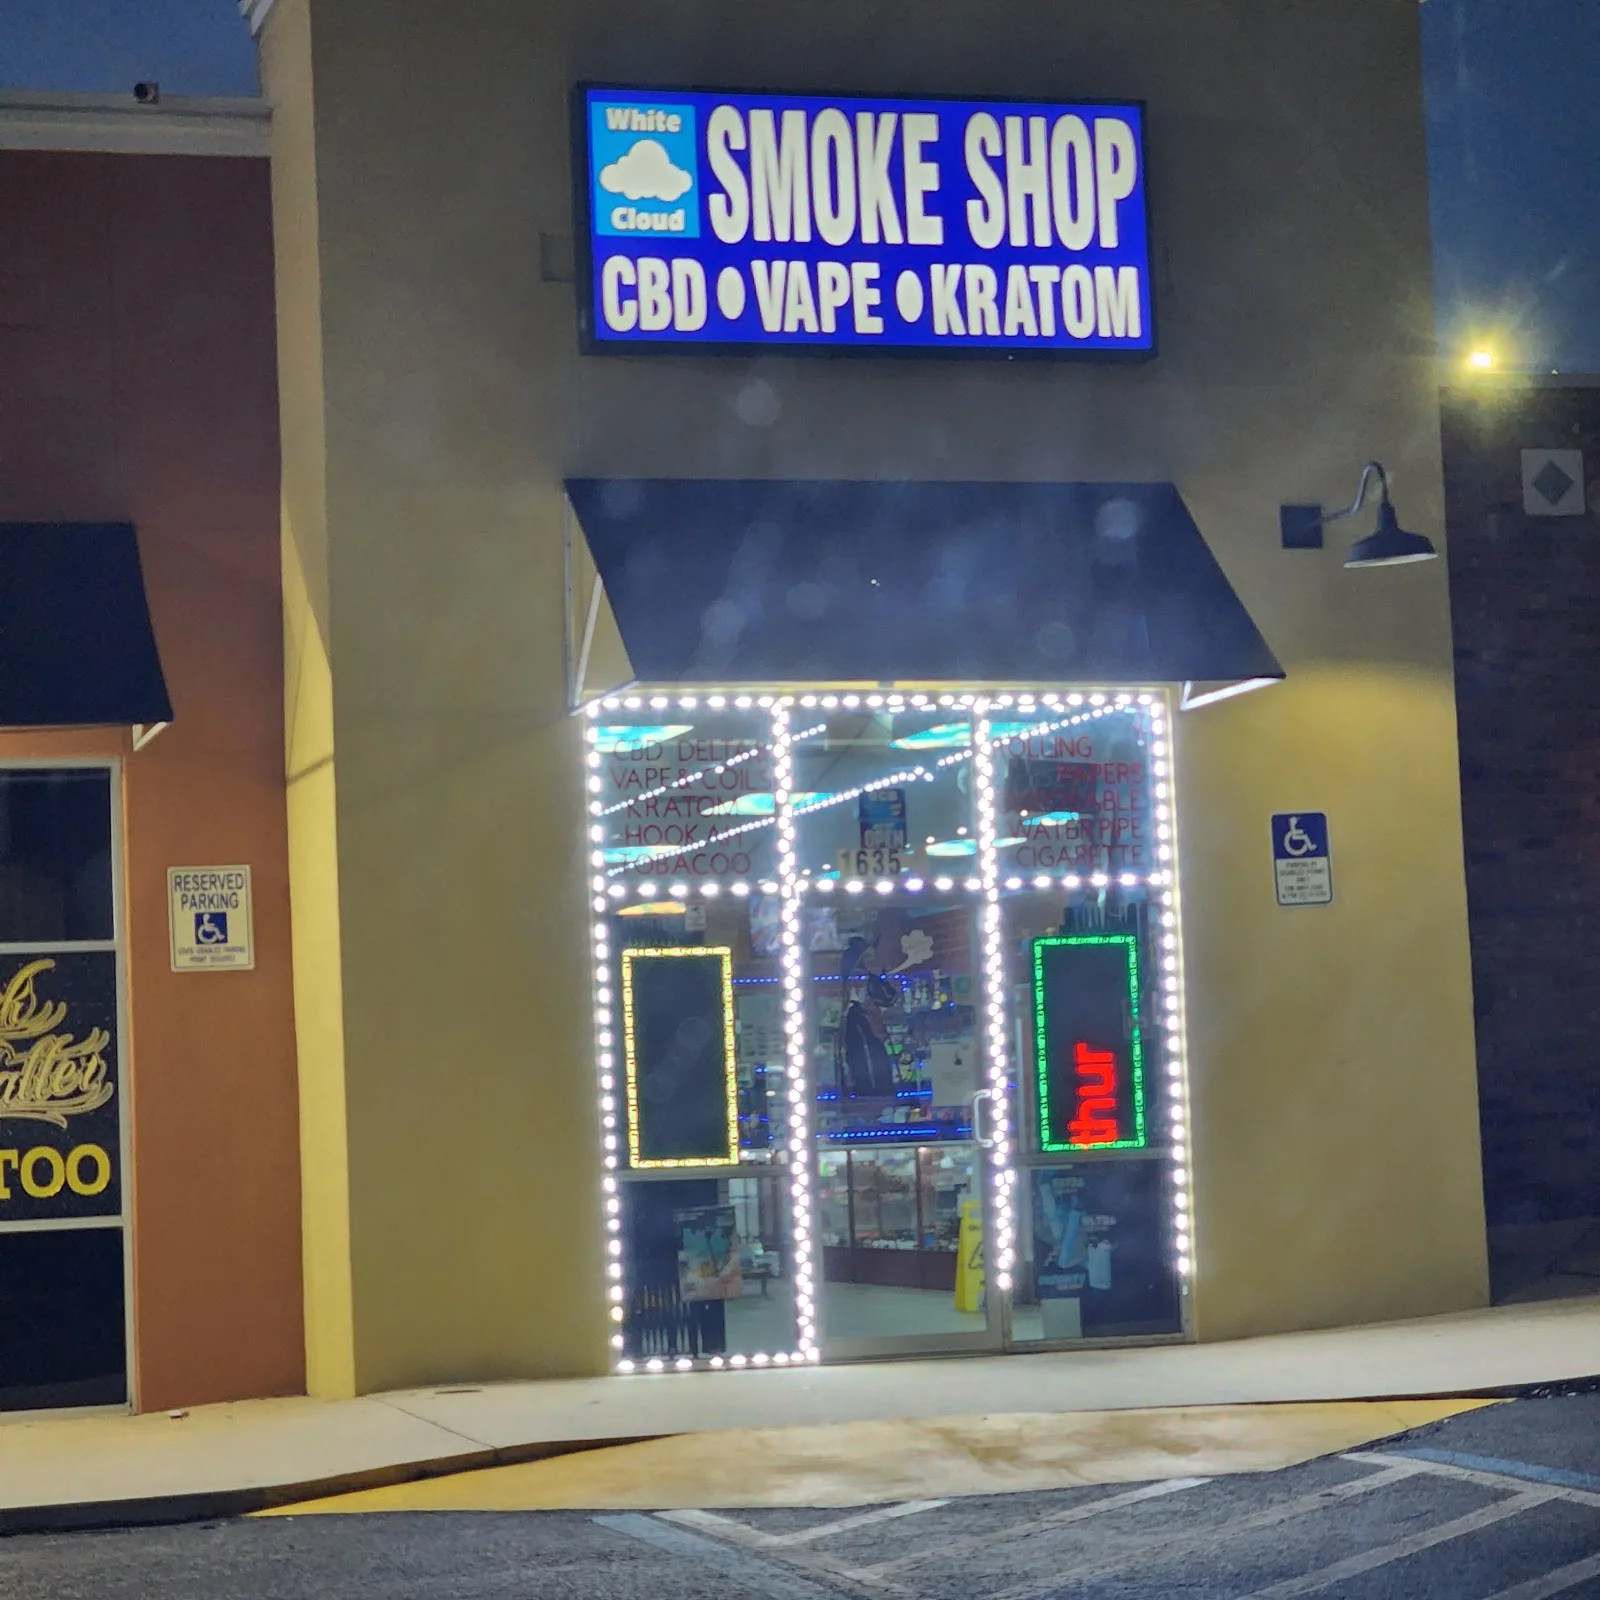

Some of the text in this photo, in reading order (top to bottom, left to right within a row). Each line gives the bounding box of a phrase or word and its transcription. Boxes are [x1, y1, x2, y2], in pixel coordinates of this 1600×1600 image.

[606, 107, 681, 133] White
[706, 104, 1137, 250] SMOKE SHOP
[611, 206, 685, 232] Cloud
[602, 254, 1141, 338] CBD VAPE KRATOM
[613, 739, 663, 762] CBD
[1057, 763, 1144, 785] PAPERS
[627, 795, 740, 818] KRATOM
[841, 850, 900, 876] 1635
[1015, 845, 1144, 868] CIGARETTE
[174, 873, 244, 892] RESERVED
[181, 892, 239, 911] PARKING
